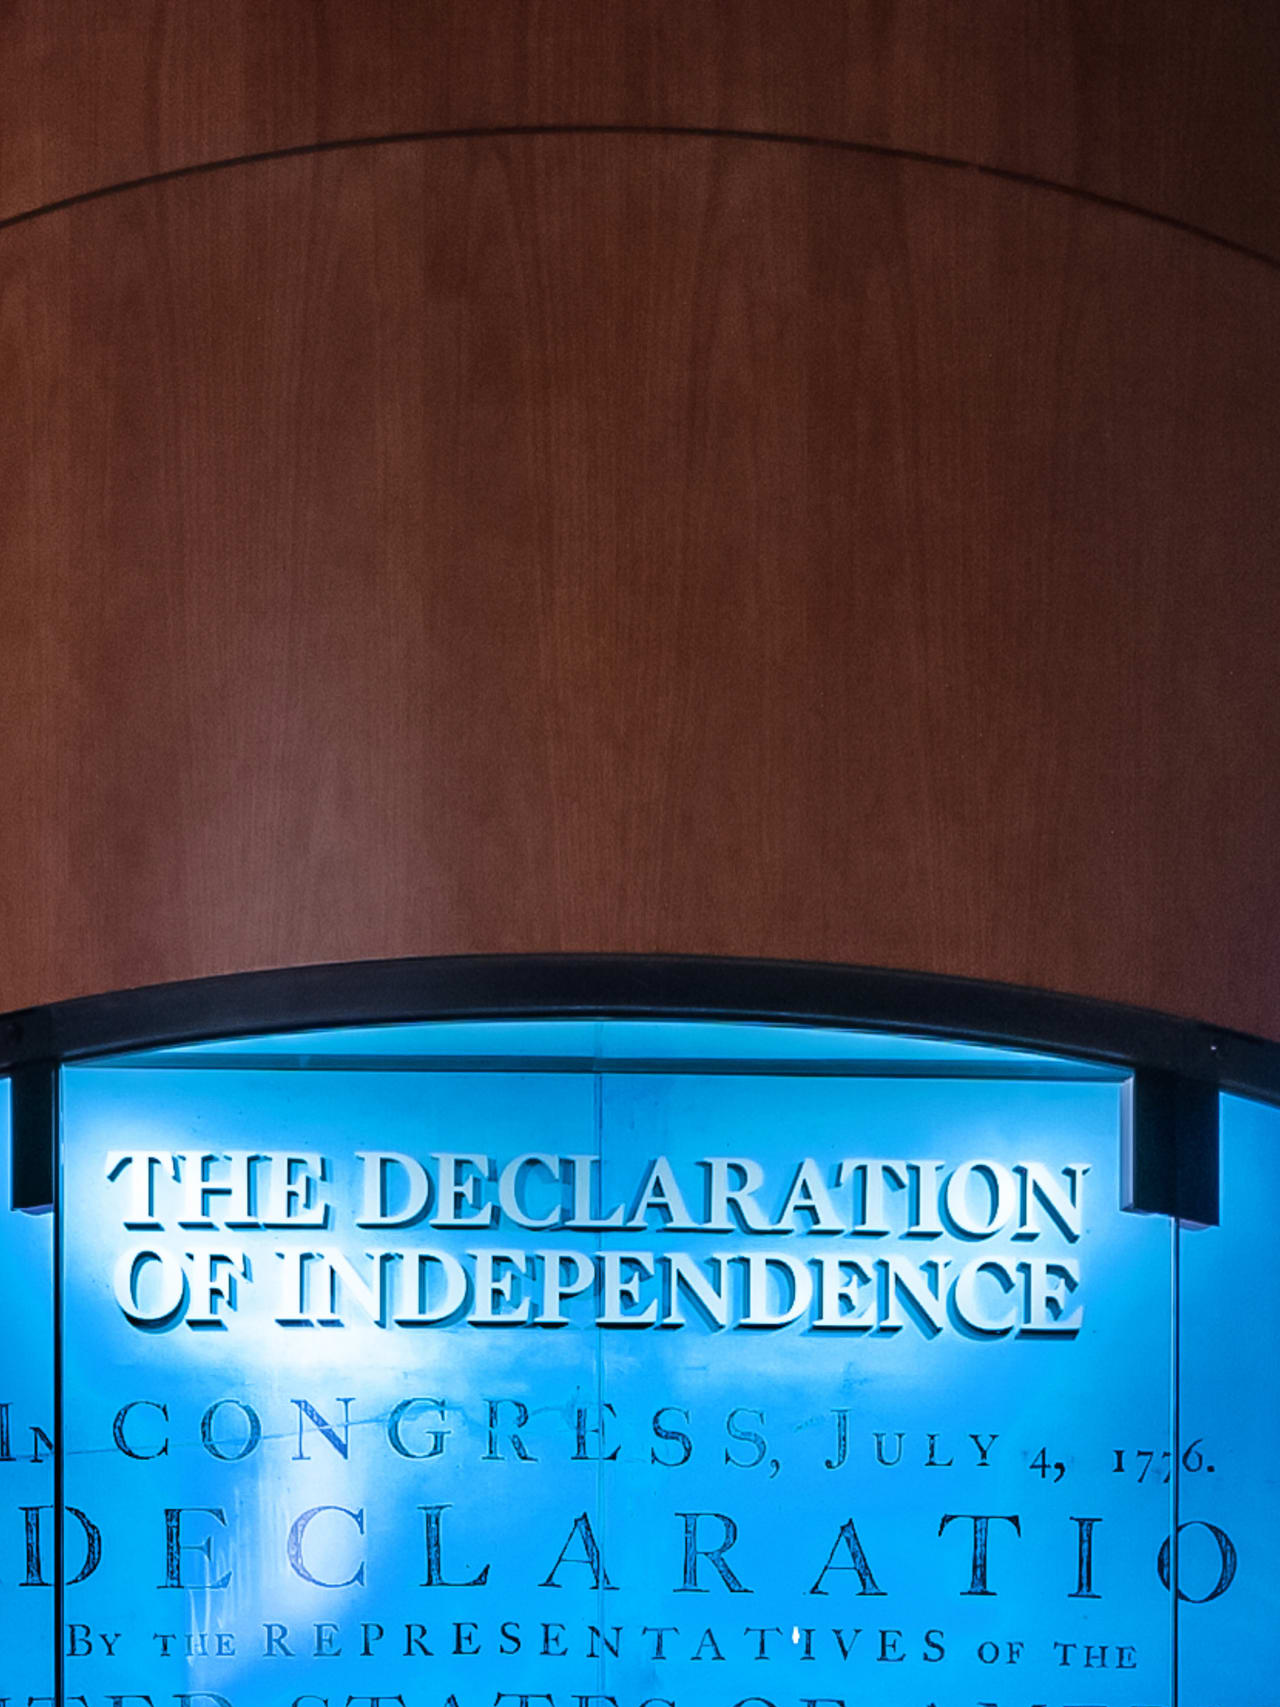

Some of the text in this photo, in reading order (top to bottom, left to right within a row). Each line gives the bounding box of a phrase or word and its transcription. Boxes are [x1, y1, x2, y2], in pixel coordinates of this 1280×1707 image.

[108, 1150, 1090, 1243] THE DECLARATION
[120, 1250, 1086, 1340] OF INDEPENDENCE
[112, 1396, 781, 1478] CONGRESS,
[825, 1408, 1001, 1471] JULY
[1029, 1447, 1066, 1483] 4,
[153, 1630, 238, 1659] THE
[263, 1622, 947, 1664] REPRESENTATIVES
[977, 1638, 1025, 1665] OF
[1054, 1640, 1138, 1670] THE
